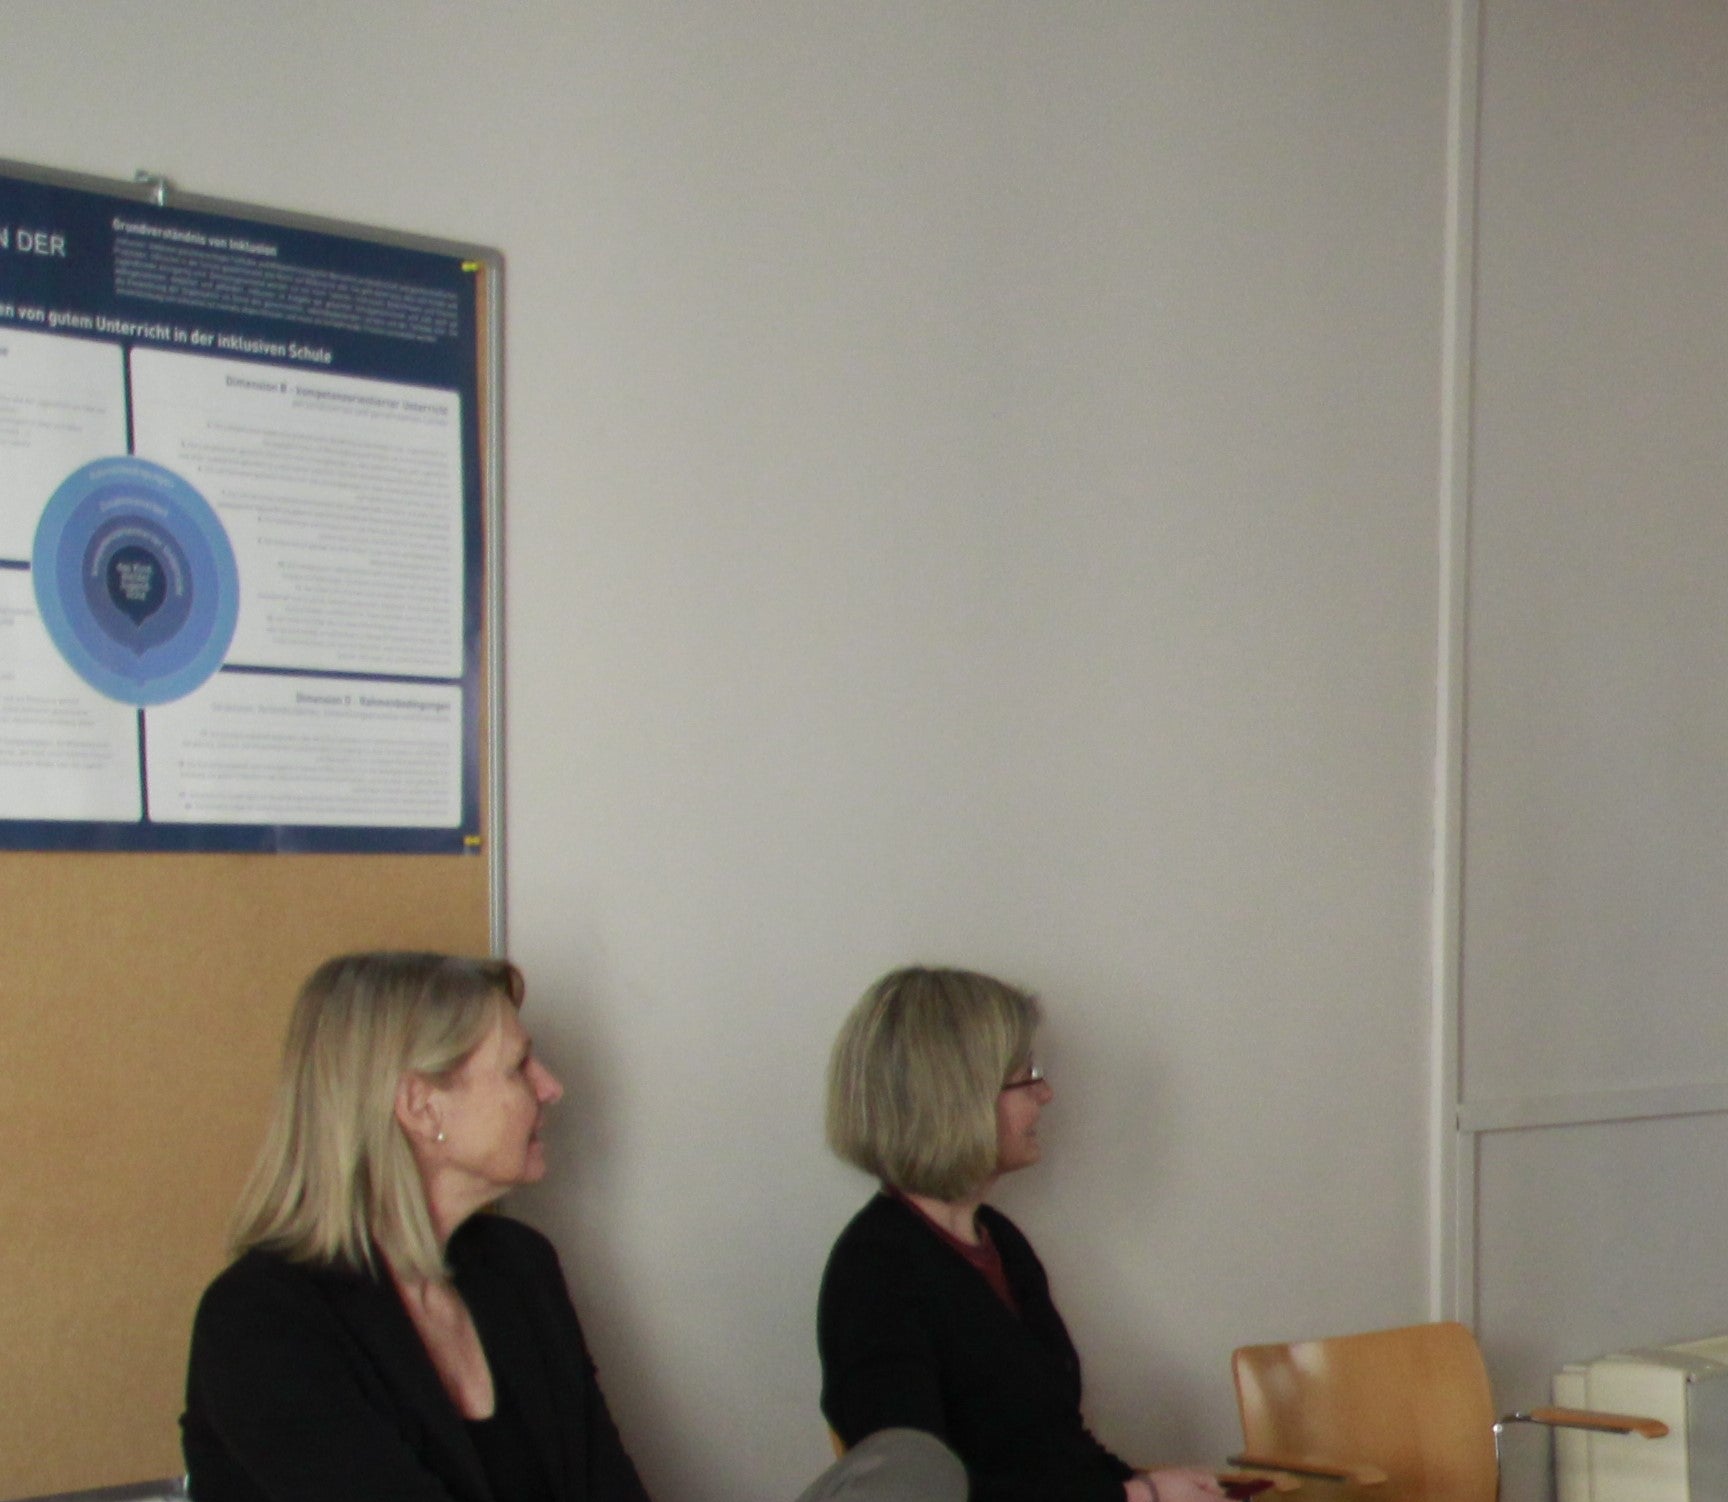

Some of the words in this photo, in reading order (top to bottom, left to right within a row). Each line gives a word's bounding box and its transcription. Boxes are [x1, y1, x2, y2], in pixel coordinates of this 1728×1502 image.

[17, 228, 66, 257] DER
[17, 306, 45, 323] von
[48, 310, 94, 328] gutem
[95, 316, 171, 340] Unterricht
[173, 326, 188, 343] in
[190, 330, 215, 347] der
[288, 341, 333, 364] Schule
